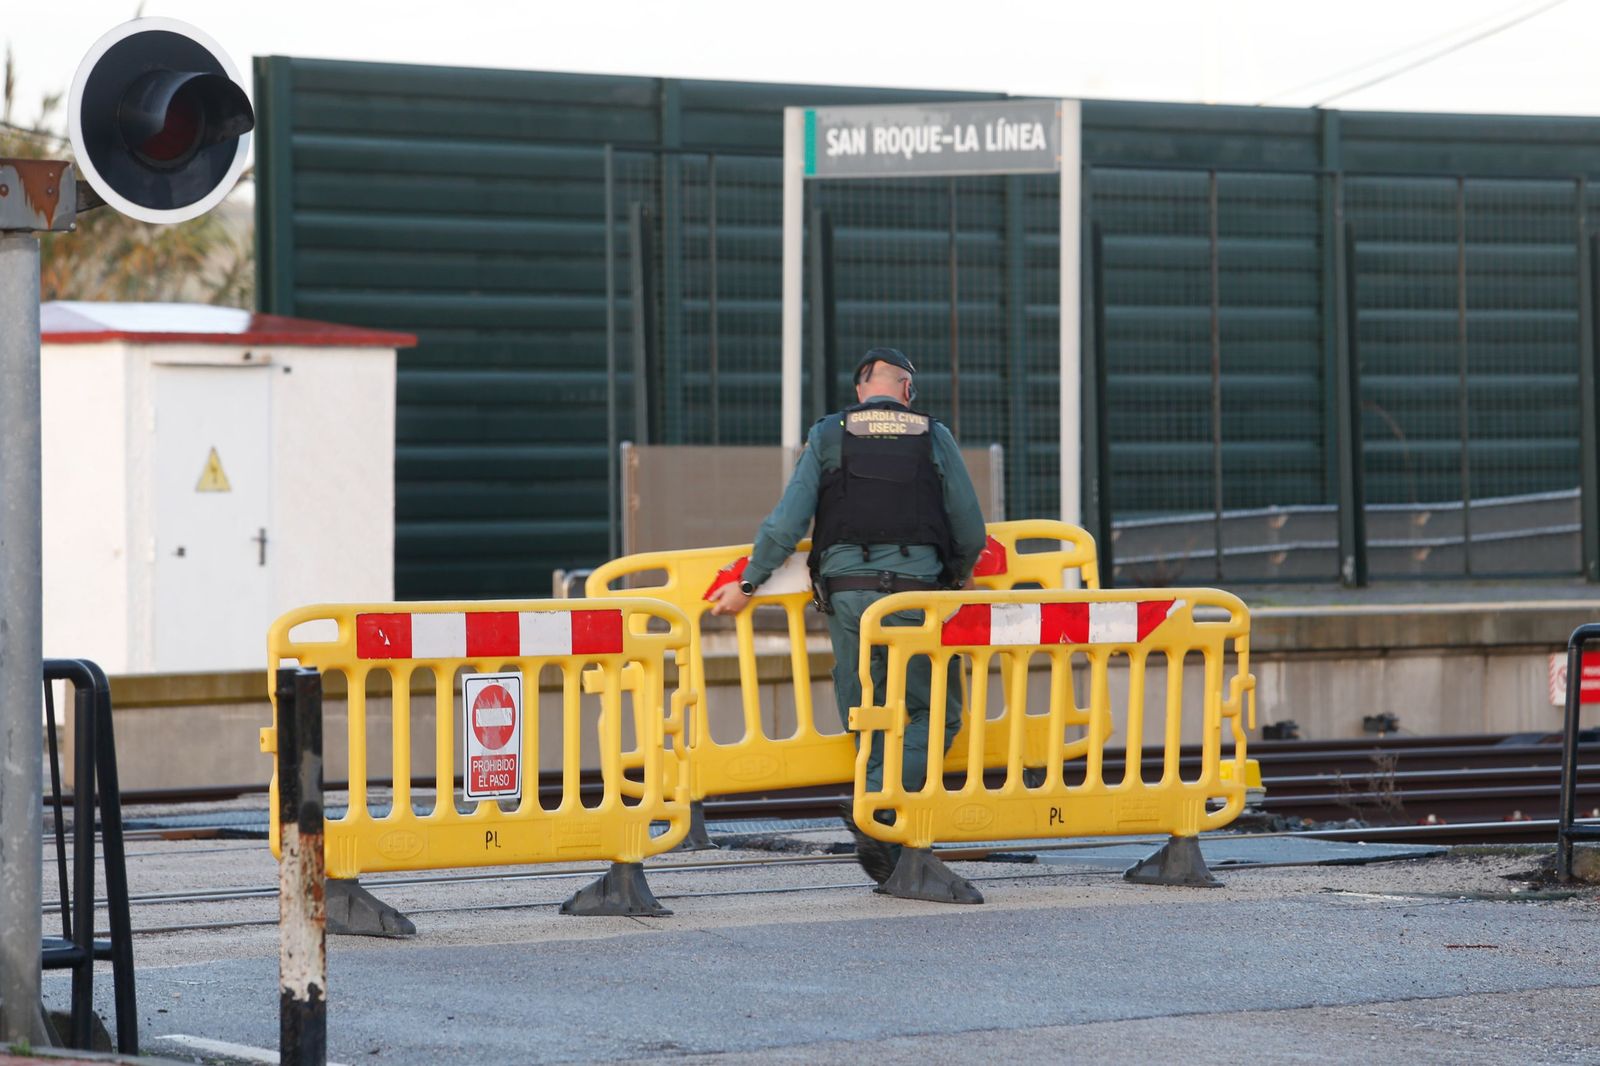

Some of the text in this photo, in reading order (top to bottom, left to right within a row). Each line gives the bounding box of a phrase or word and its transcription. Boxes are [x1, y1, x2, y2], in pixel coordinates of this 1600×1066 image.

[826, 117, 1047, 160] SAN ROQUE-LA LÍNEA
[851, 411, 925, 425] GUARDIA CIVIL
[868, 422, 907, 433] USECIC
[473, 758, 515, 773] PROHIBIDO
[478, 774, 510, 788] EL PASO
[1050, 807, 1065, 826] PL
[485, 830, 501, 850] PL
